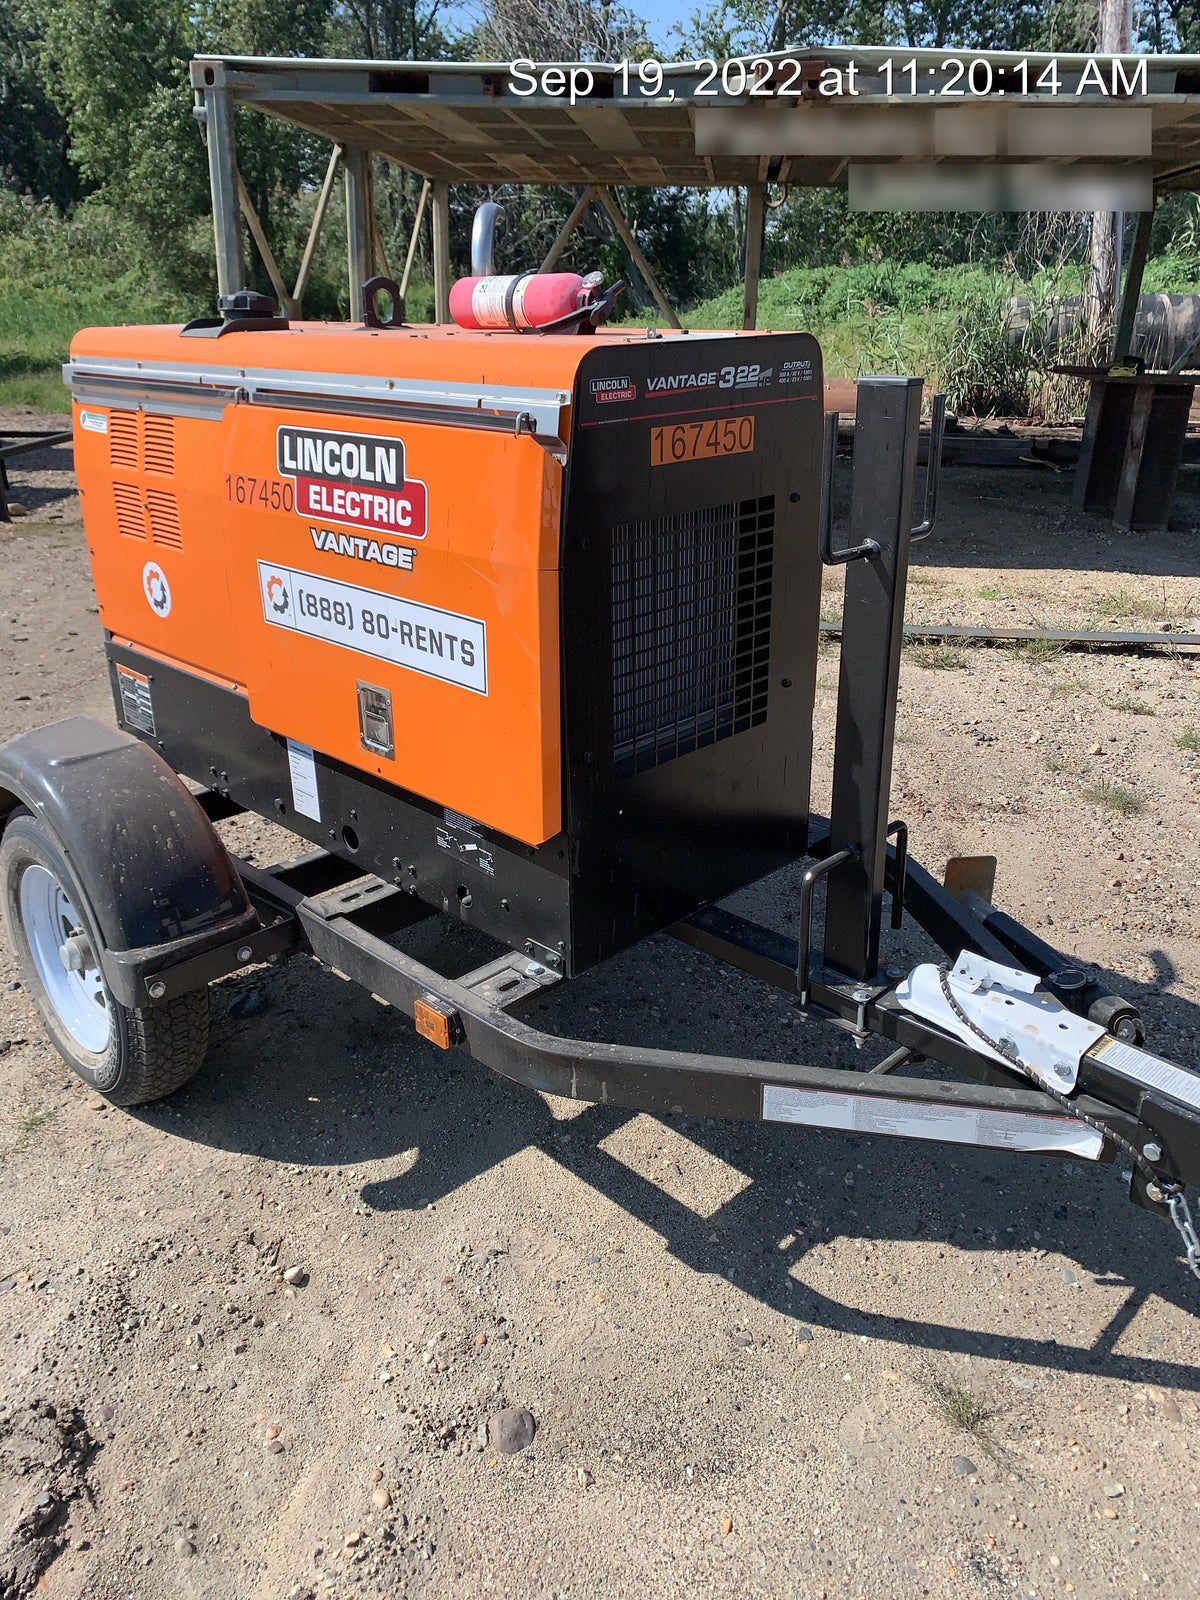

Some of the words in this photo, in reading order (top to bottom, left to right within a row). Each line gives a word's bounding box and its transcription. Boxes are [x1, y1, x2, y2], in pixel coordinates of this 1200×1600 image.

[592, 379, 628, 392] LINCOLN
[600, 390, 632, 400] ELECTRIC
[646, 372, 716, 391] VANTAGE
[718, 364, 760, 389] 322
[283, 435, 397, 484] LINCOLN
[654, 417, 753, 462] 167450
[226, 475, 294, 512] 167450
[309, 484, 412, 527] ELECTRIC
[309, 526, 414, 571] VANTAGE
[298, 589, 354, 631] (888)
[361, 608, 475, 667] 80-RENTS
